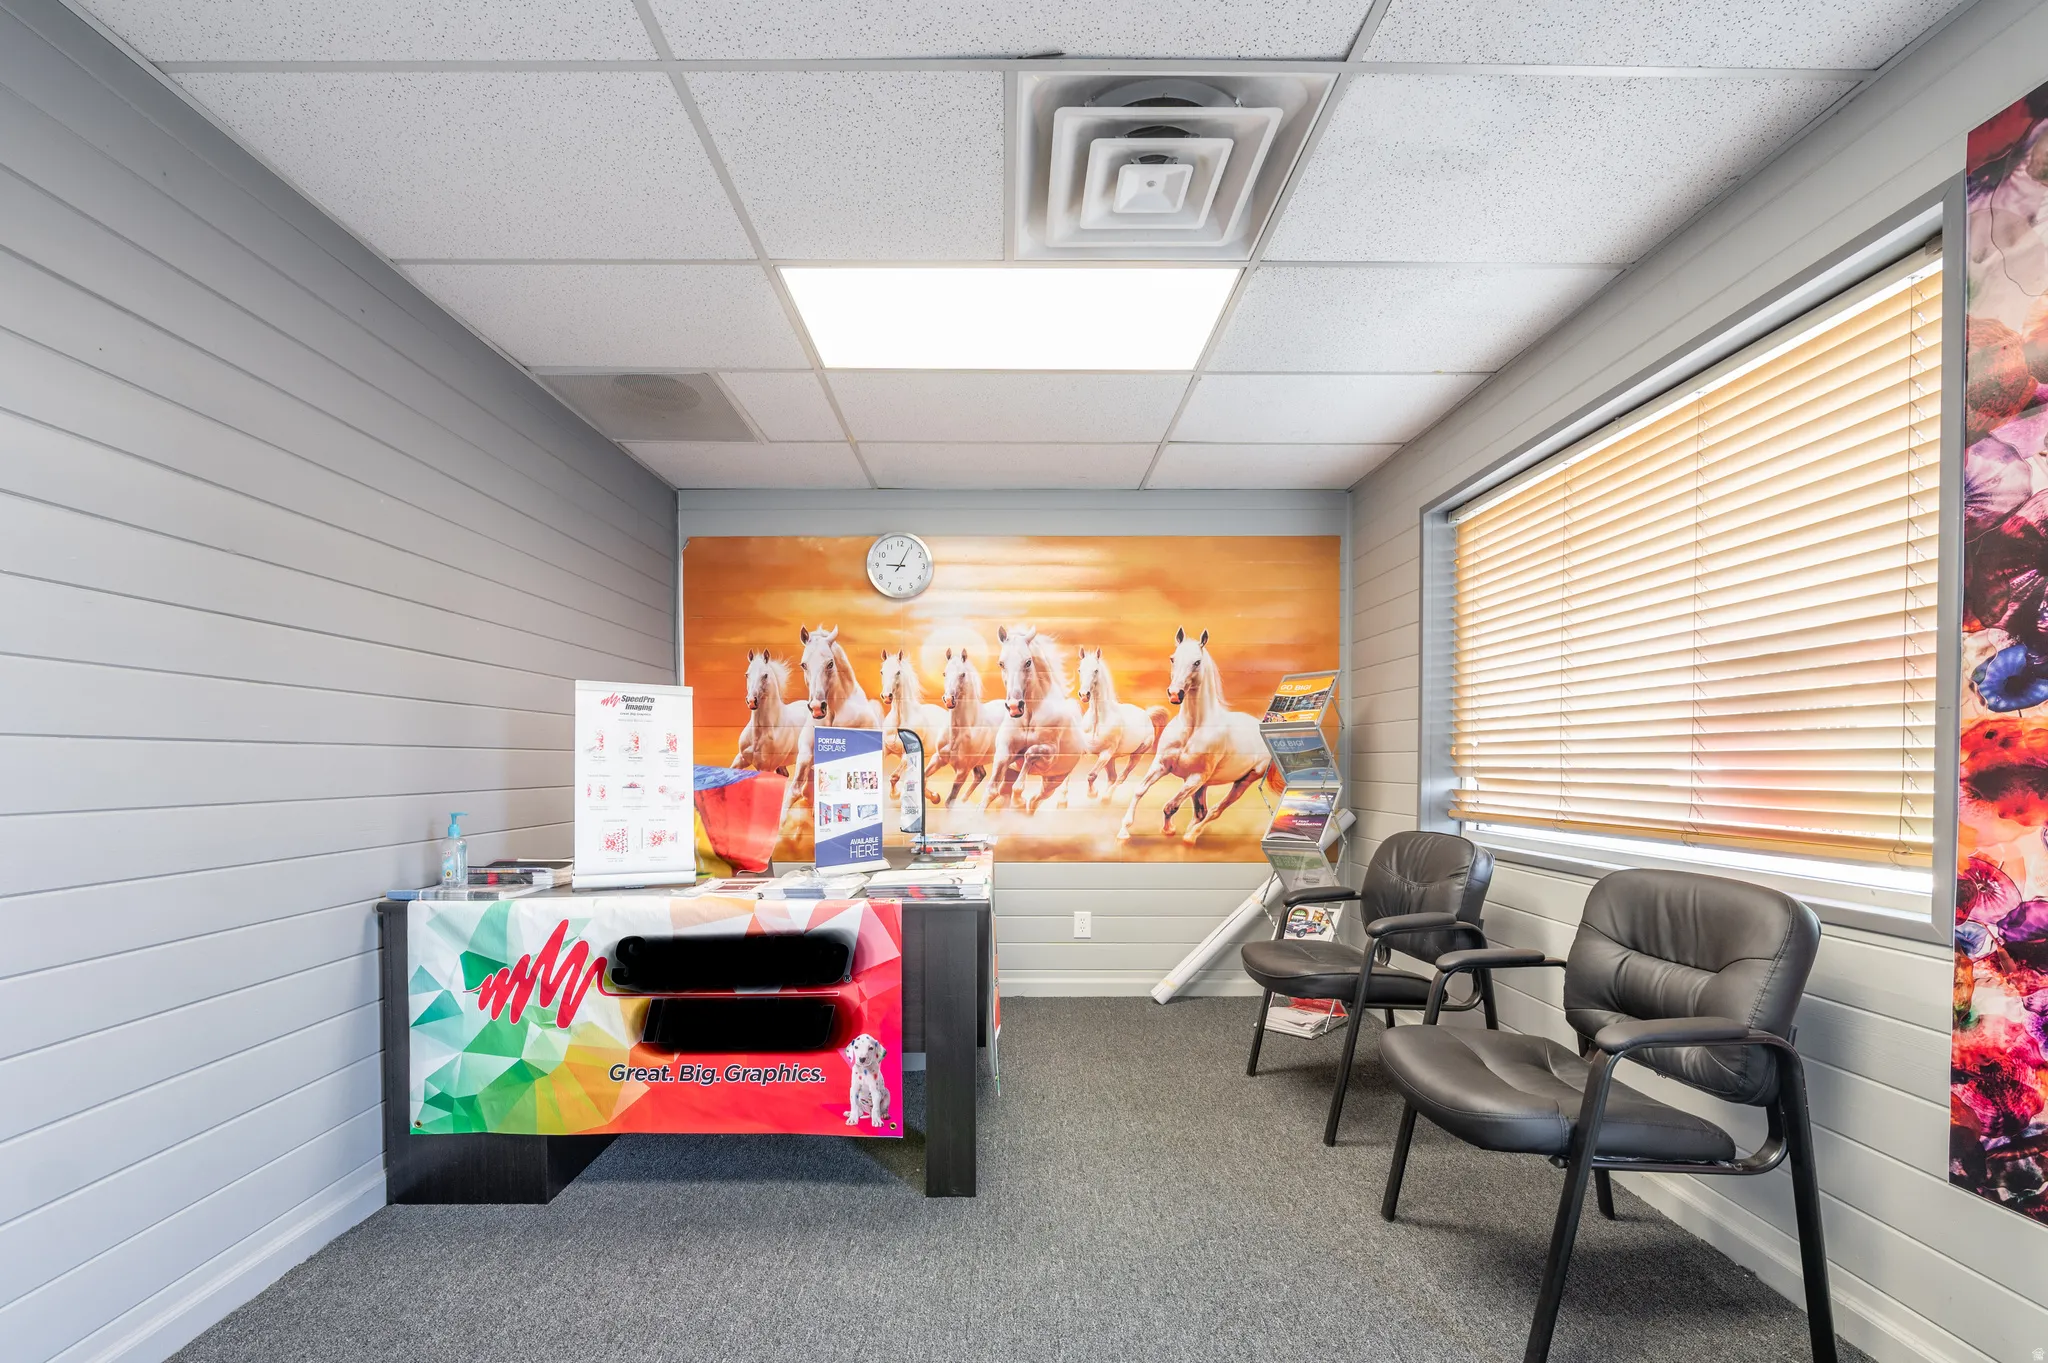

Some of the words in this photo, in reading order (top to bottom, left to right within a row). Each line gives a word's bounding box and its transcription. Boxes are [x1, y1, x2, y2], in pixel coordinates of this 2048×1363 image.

[621, 695, 655, 703] SpeedPro
[850, 836, 879, 845] AVAILABLE
[850, 844, 879, 858] HERE
[608, 1064, 674, 1083] Great.
[678, 1064, 720, 1086] Big.
[724, 1064, 826, 1086] Graphics.
